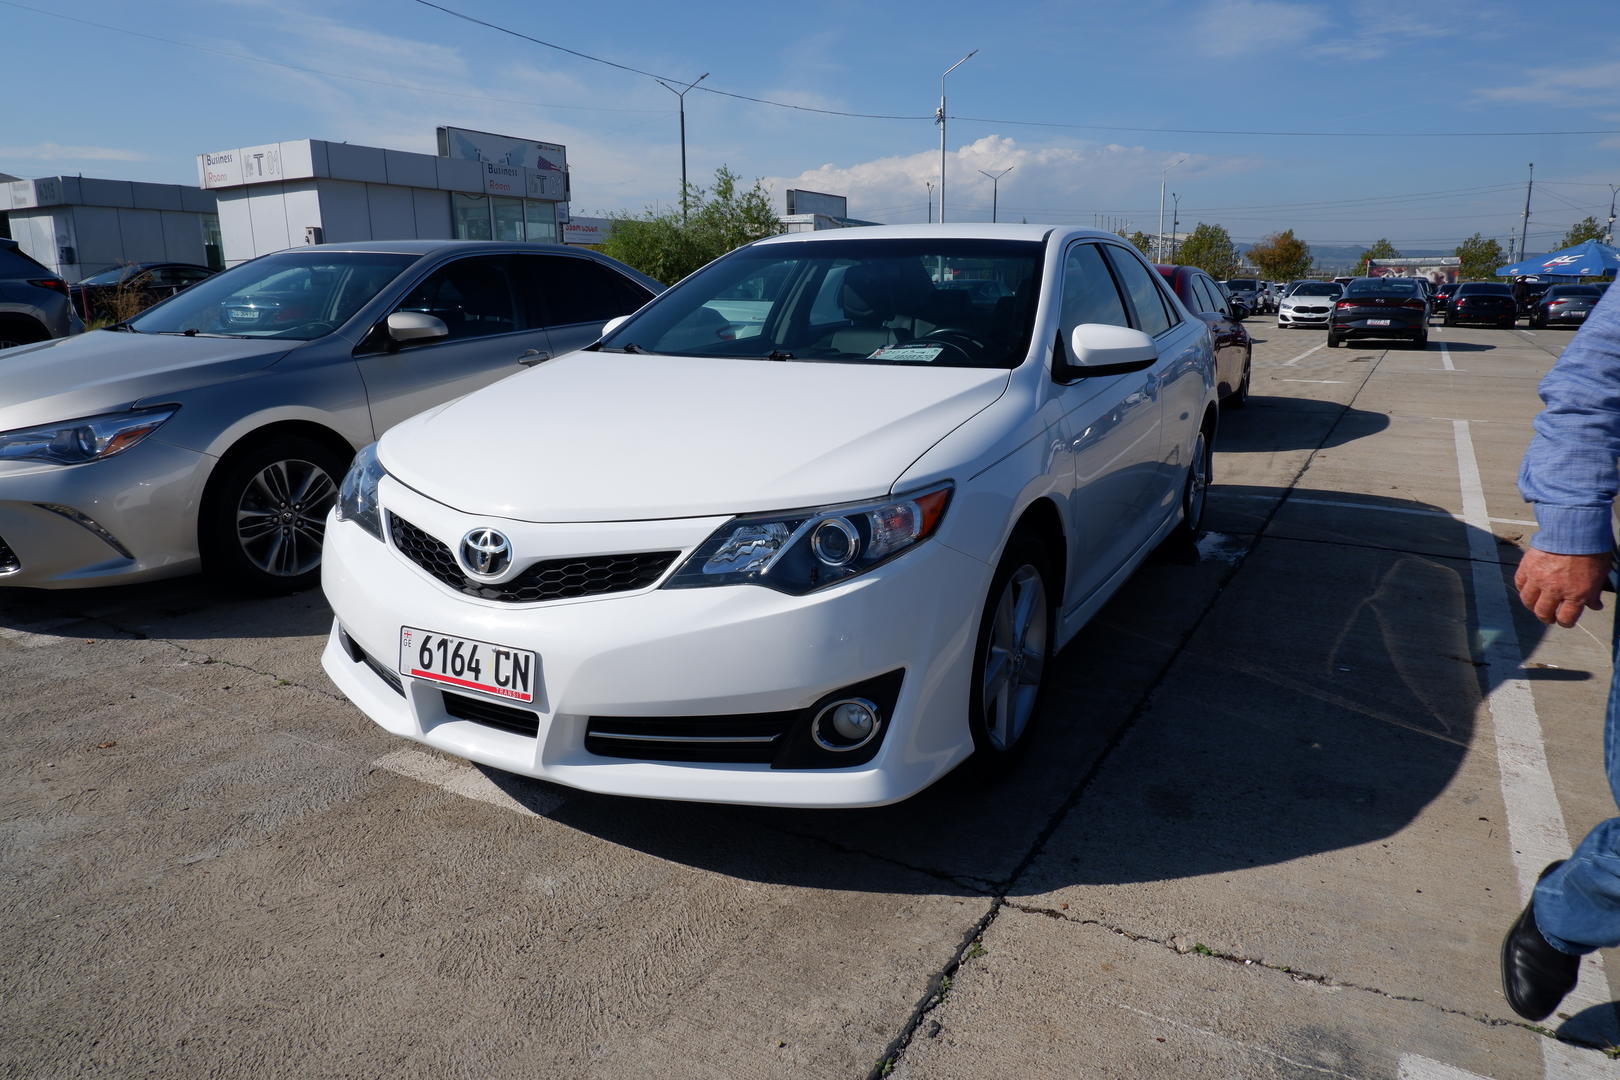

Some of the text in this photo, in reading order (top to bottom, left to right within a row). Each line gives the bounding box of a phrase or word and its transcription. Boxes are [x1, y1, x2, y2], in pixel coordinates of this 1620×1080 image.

[206, 153, 233, 166] Business
[403, 638, 412, 648] GE
[418, 634, 531, 692] 6164 CN
[495, 687, 523, 699] TRANSIT
